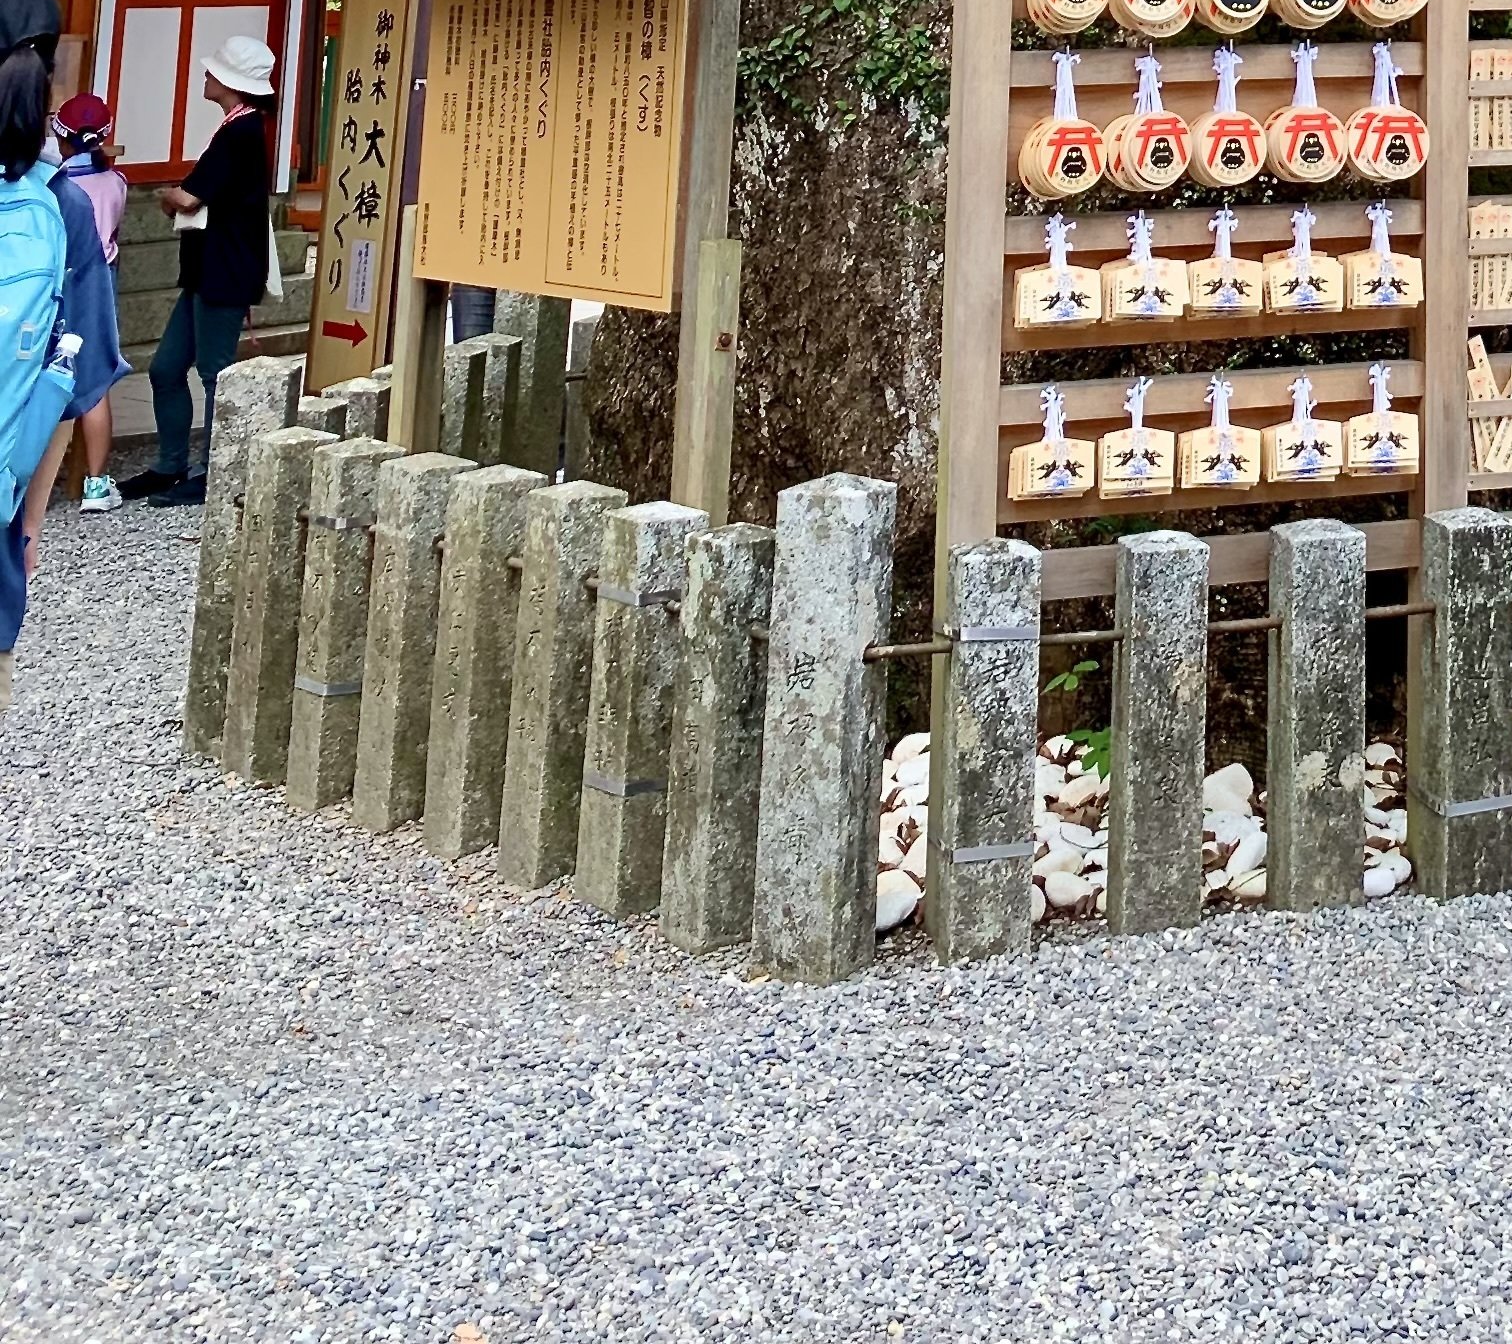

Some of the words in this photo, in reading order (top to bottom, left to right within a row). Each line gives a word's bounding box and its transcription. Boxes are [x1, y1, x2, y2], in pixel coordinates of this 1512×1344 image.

[328, 67, 364, 295] 胎内くぐり
